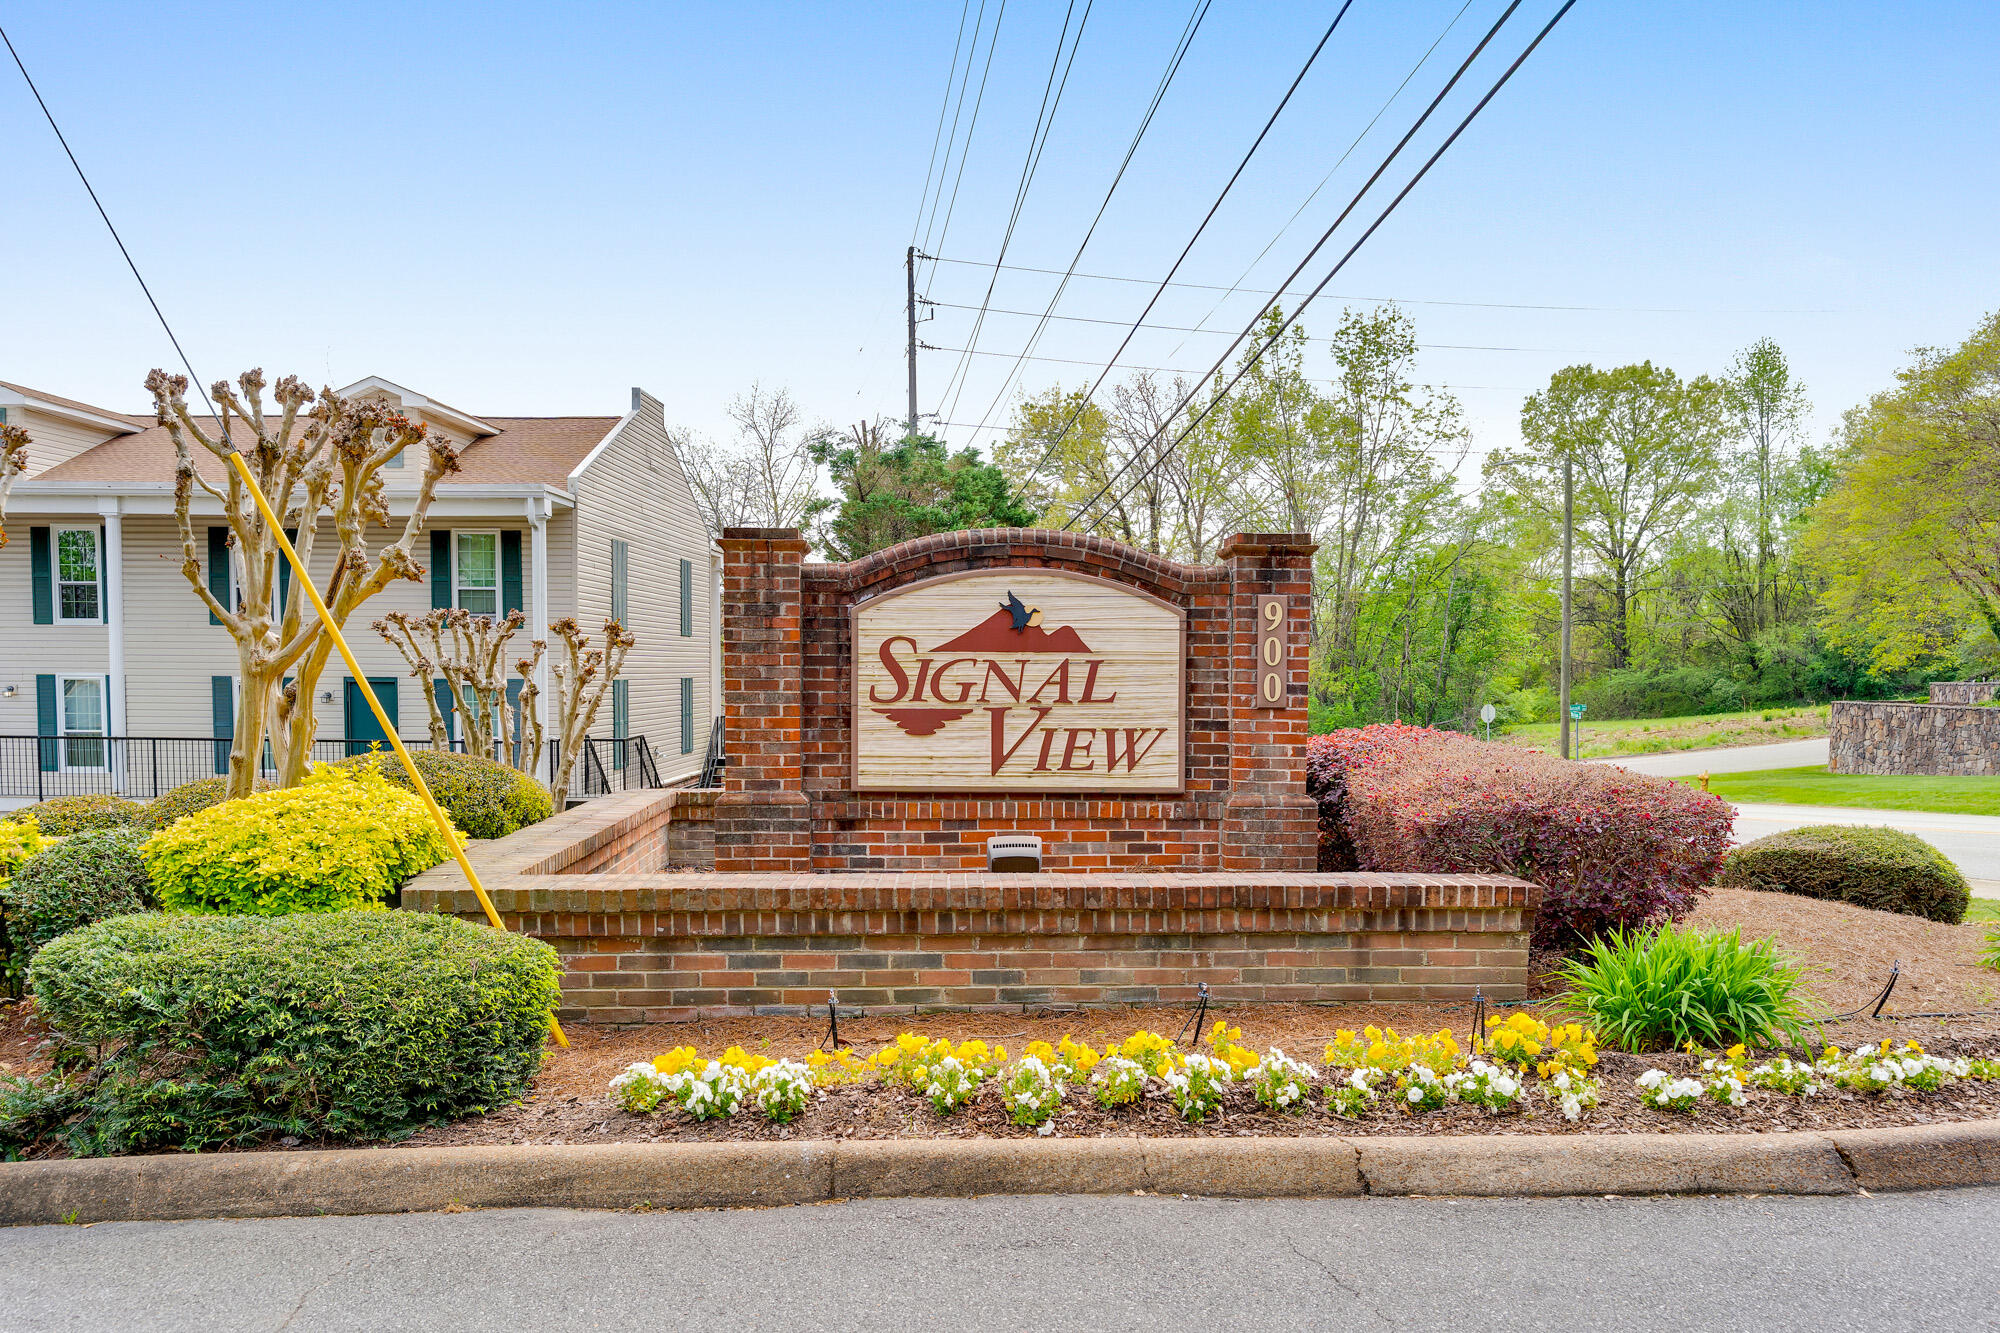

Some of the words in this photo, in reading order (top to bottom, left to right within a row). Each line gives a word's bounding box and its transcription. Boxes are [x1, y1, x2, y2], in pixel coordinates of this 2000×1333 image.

[869, 636, 1118, 704] SIGNAL
[1263, 601, 1283, 703] 900
[983, 706, 1168, 777] VIEW
